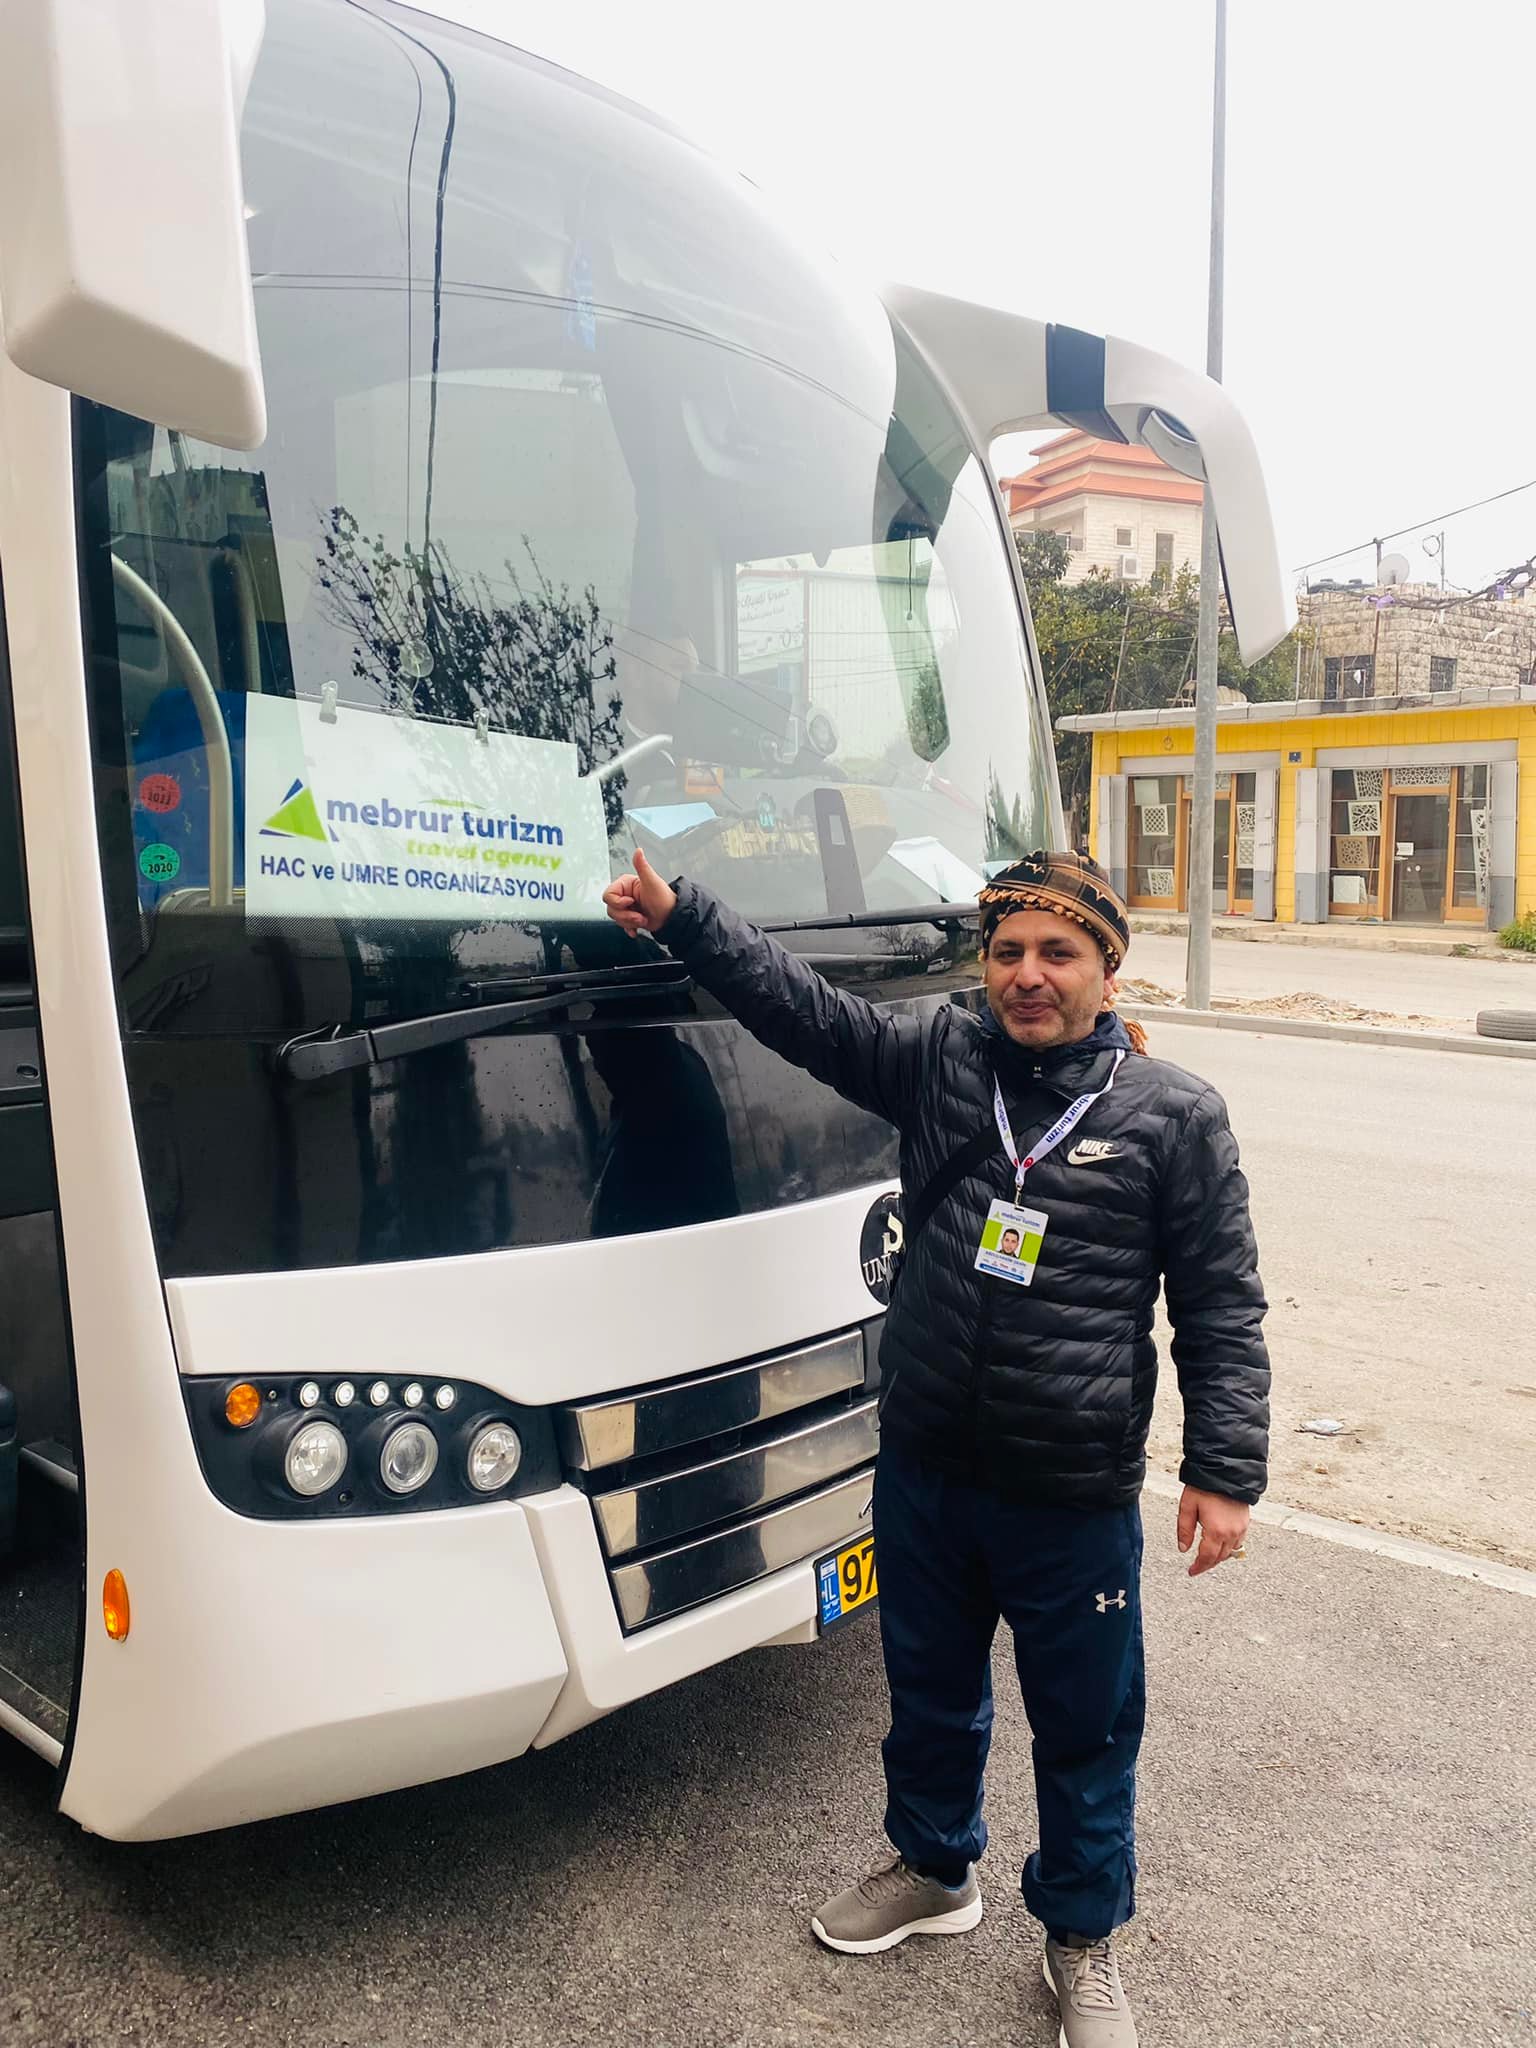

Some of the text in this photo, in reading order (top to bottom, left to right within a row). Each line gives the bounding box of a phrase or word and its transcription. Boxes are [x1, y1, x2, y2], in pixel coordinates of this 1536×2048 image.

[327, 798, 563, 846] mebrur turizm
[148, 862, 173, 875] 2020
[406, 839, 562, 871] travel agency
[260, 855, 564, 902] HAC ve UMRE ORGANİZASYONU
[1076, 1139, 1114, 1157] NIKE
[823, 1577, 837, 1603] IL
[843, 1545, 876, 1603] 97
